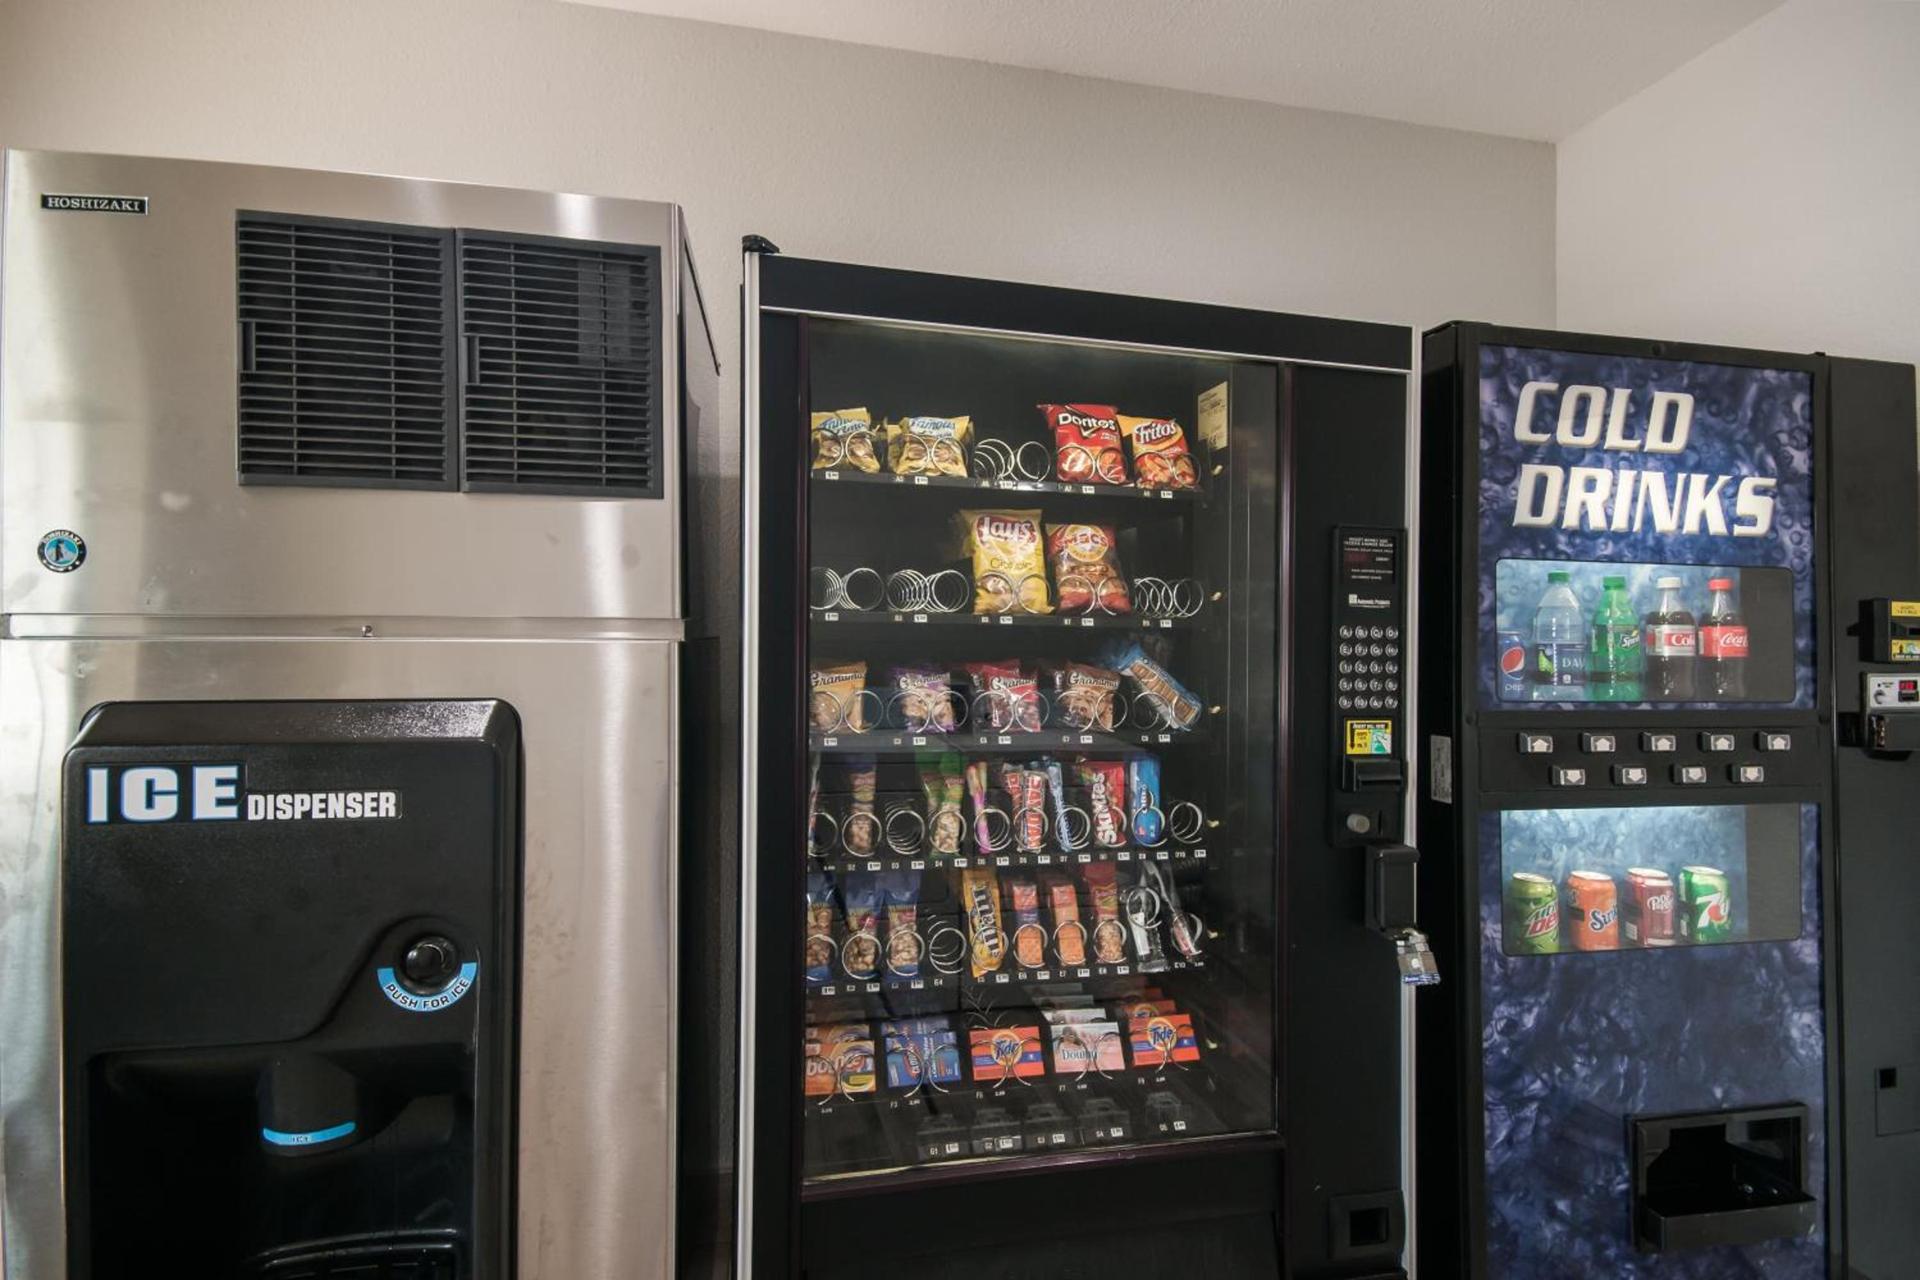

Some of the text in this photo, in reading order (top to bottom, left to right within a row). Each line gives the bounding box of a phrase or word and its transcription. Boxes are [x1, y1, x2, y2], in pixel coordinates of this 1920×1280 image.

[47, 197, 140, 211] HOSHIZAKI
[1058, 412, 1116, 431] Doritos
[1514, 381, 1695, 454] COLD
[1135, 419, 1178, 444] Fritos
[1512, 463, 1777, 537] DRINKS
[86, 765, 397, 823] ICE DISPENSER
[385, 979, 469, 1009] PUSH FOR ICE
[1152, 1026, 1174, 1046] Tide
